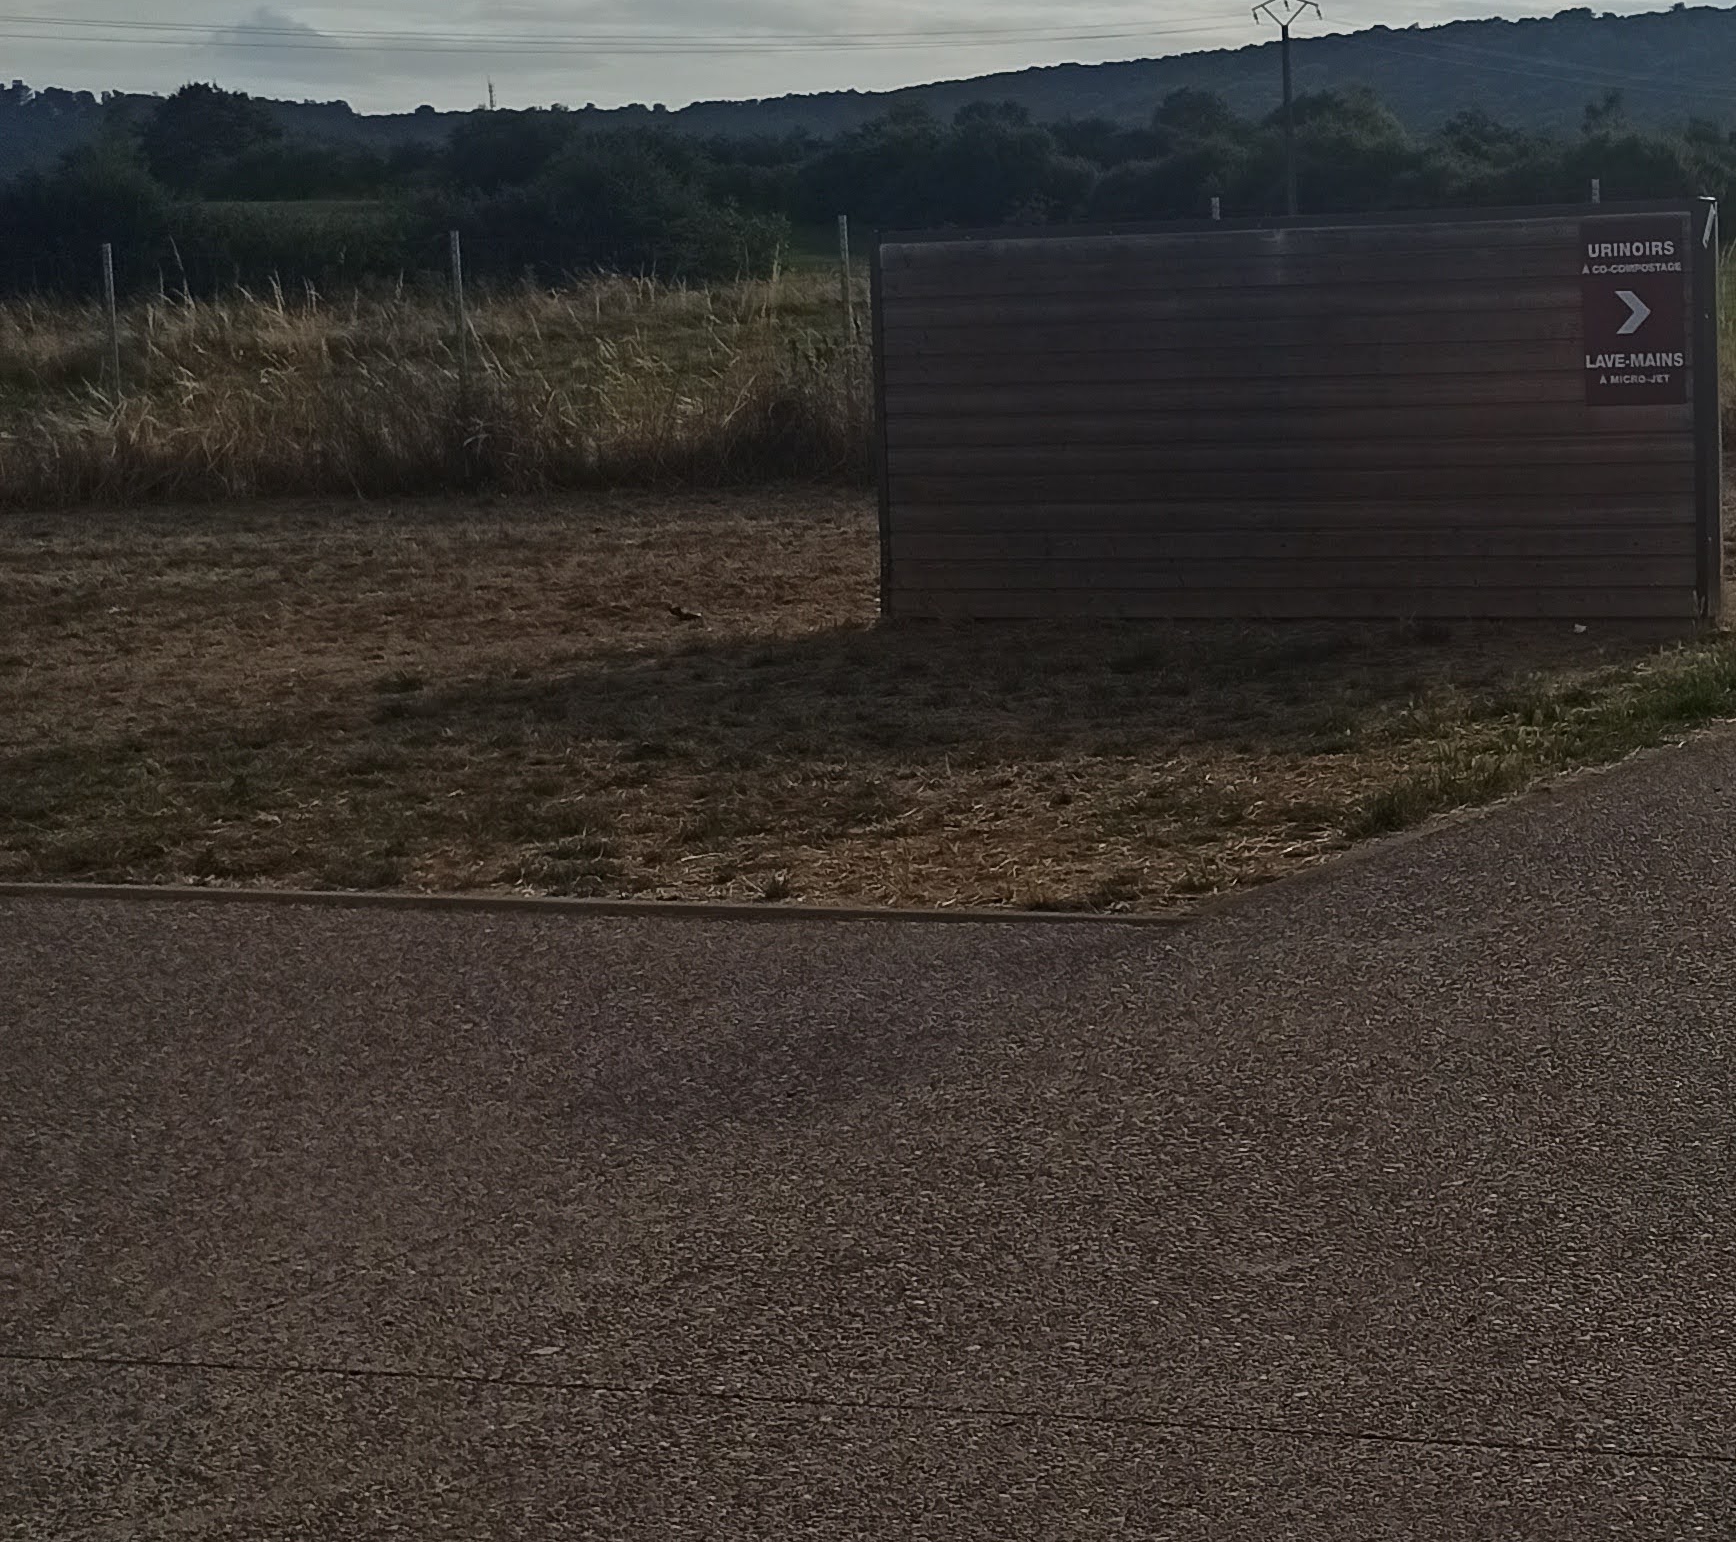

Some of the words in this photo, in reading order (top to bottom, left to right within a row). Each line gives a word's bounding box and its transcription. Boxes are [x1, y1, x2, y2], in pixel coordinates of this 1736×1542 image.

[1588, 240, 1675, 258] URINOIRS
[1592, 261, 1682, 274] CO-COMPOSTAGE
[1585, 352, 1684, 368] LAVE-MAINS
[1610, 374, 1671, 384] MICRO-JET
